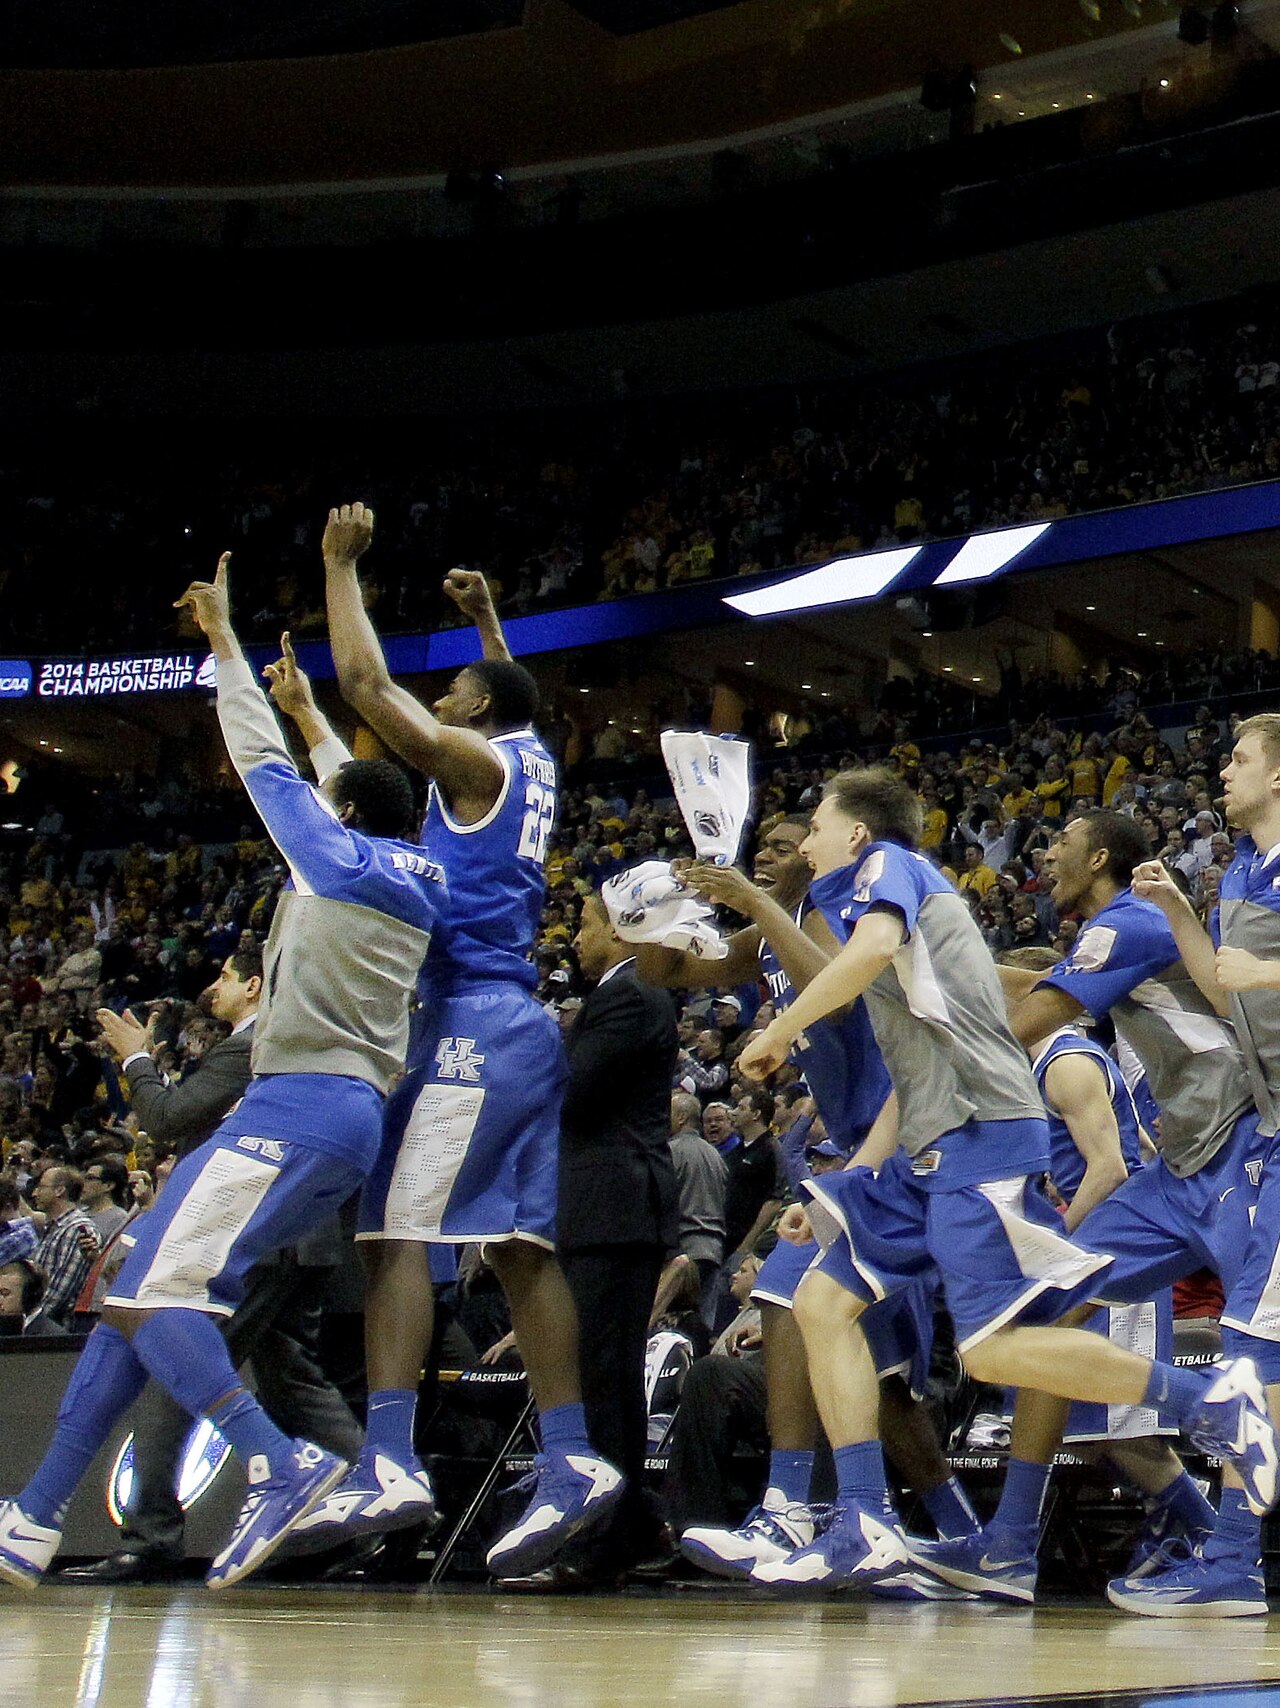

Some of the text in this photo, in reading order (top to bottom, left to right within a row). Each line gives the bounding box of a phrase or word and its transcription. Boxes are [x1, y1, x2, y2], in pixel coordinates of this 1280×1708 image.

[40, 656, 194, 679] 2014 BASKETBALL
[0, 677, 29, 692] CAA
[38, 670, 192, 697] CHAMPIONSHIP
[517, 782, 555, 864] 22
[435, 1036, 485, 1082] UK
[1173, 1353, 1212, 1366] ETBALL
[469, 1372, 520, 1383] BASKETBALL
